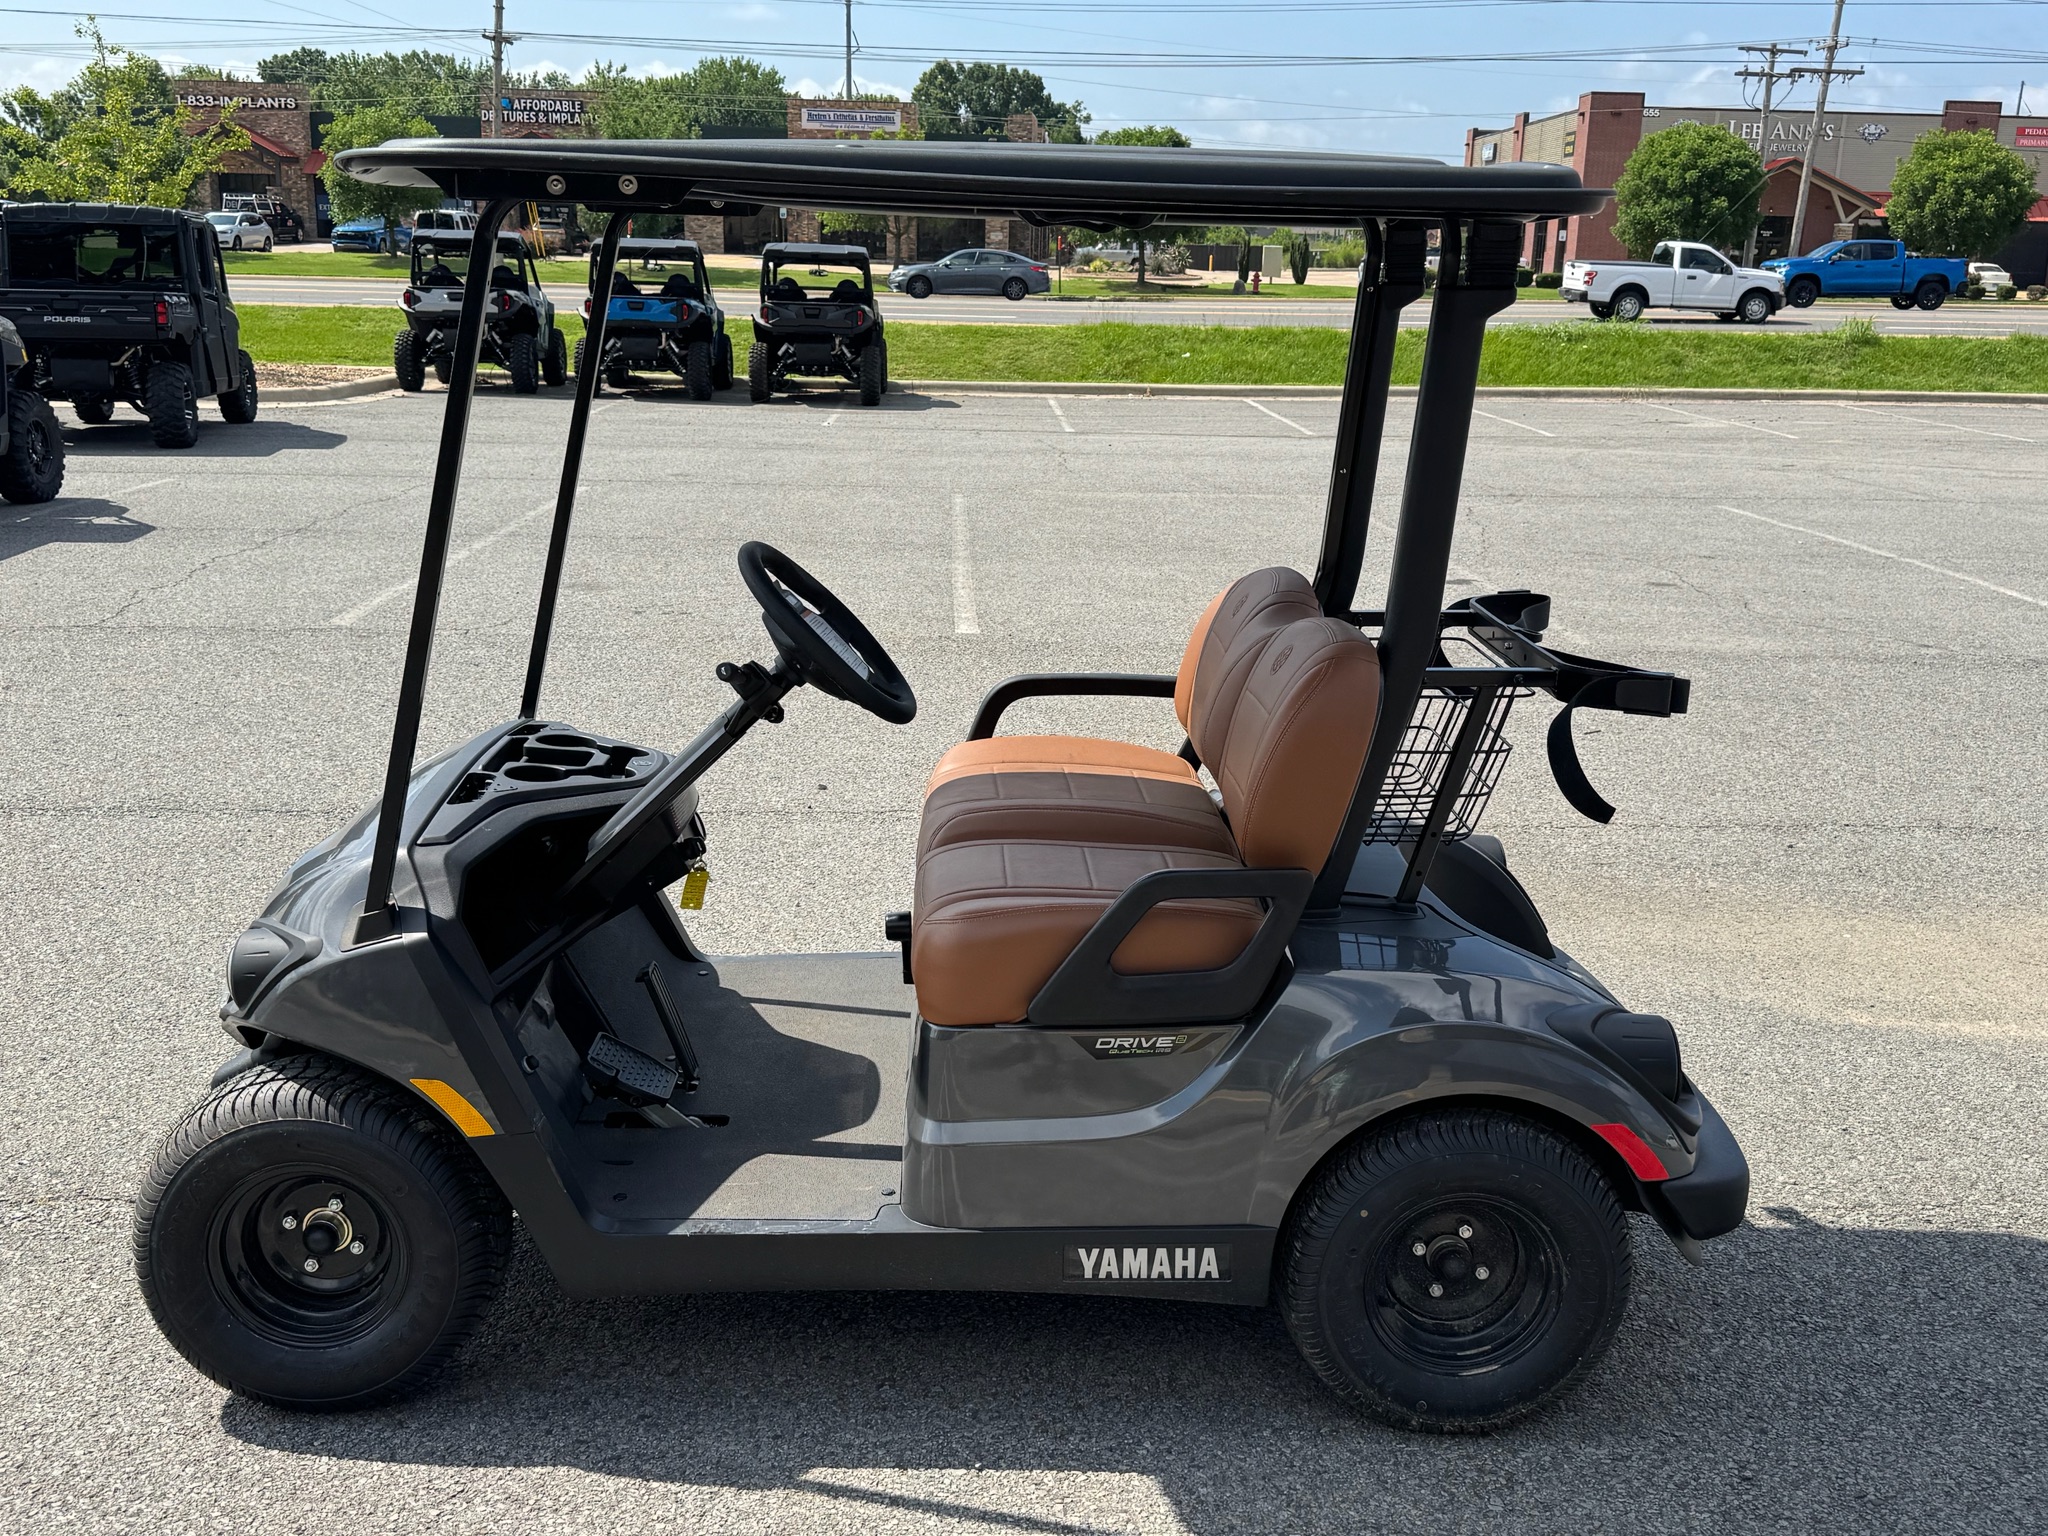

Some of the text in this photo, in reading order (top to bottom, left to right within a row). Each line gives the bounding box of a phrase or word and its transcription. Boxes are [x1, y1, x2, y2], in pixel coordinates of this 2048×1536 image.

[513, 99, 582, 113] AFFORDABLE
[481, 110, 537, 123] DETURES
[538, 112, 547, 123] &
[1643, 108, 1660, 117] 655
[1769, 143, 1807, 152] JEWELRY
[43, 315, 91, 323] POLARIS
[1078, 1248, 1219, 1279] YAMAHA
